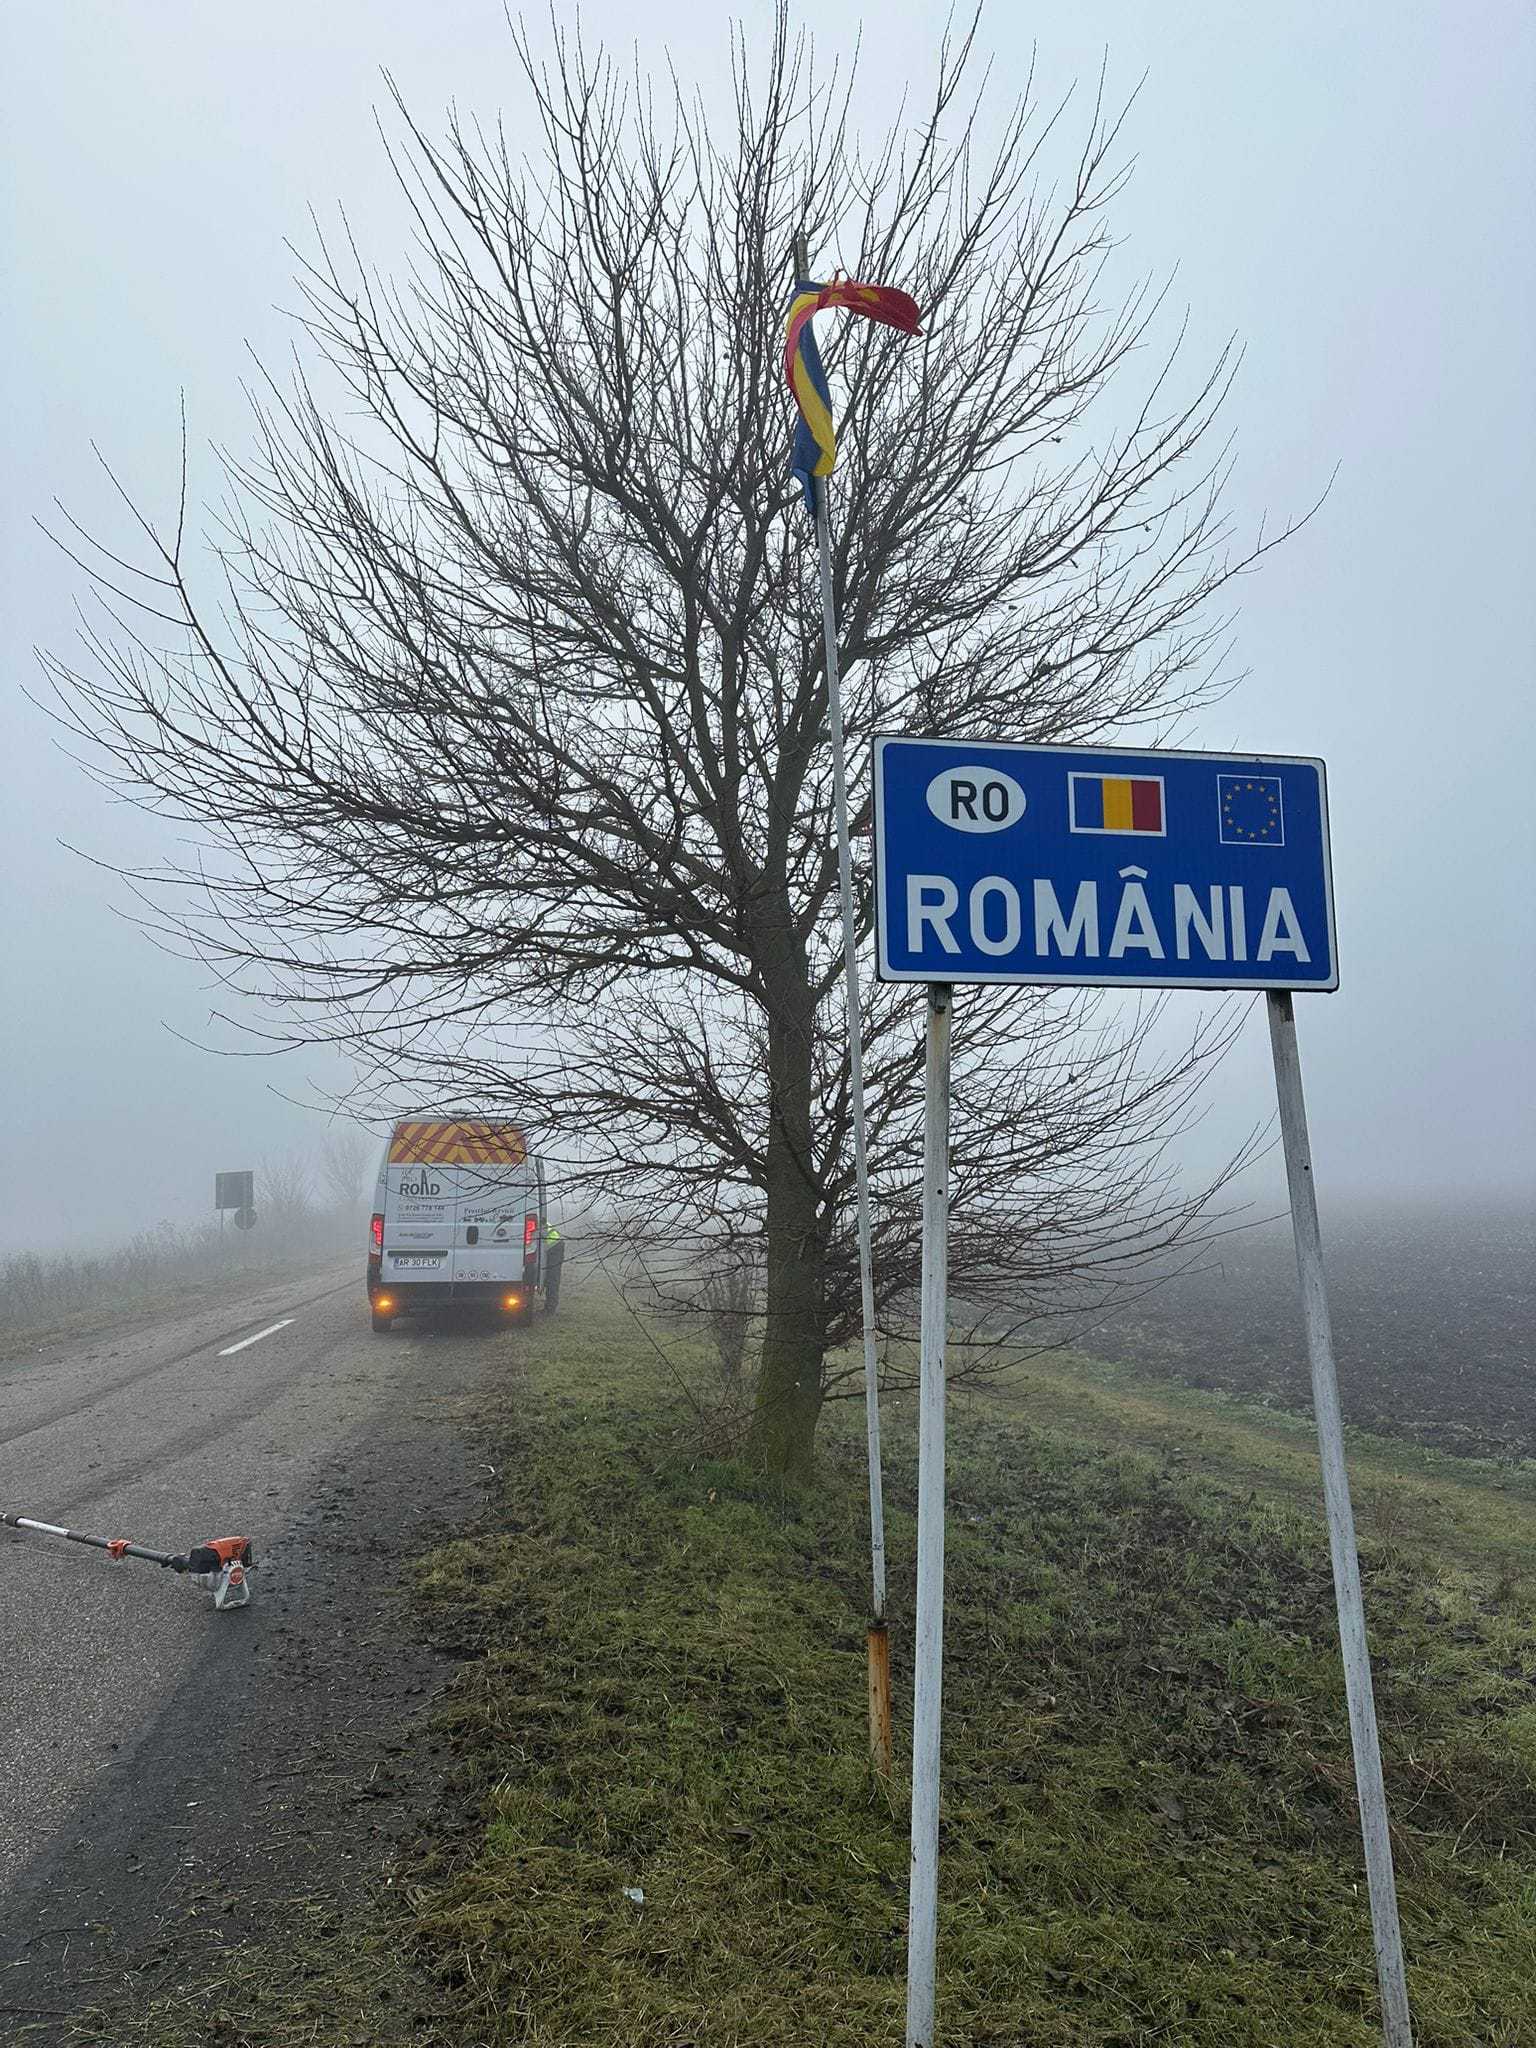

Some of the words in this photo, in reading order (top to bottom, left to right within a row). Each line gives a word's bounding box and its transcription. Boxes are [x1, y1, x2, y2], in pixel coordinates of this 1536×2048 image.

[950, 779, 1010, 822] RO
[906, 864, 1312, 963] ROMÂNIA
[400, 1169, 440, 1196] ROAD
[399, 1258, 409, 1266] AR
[422, 1258, 438, 1266] FLK
